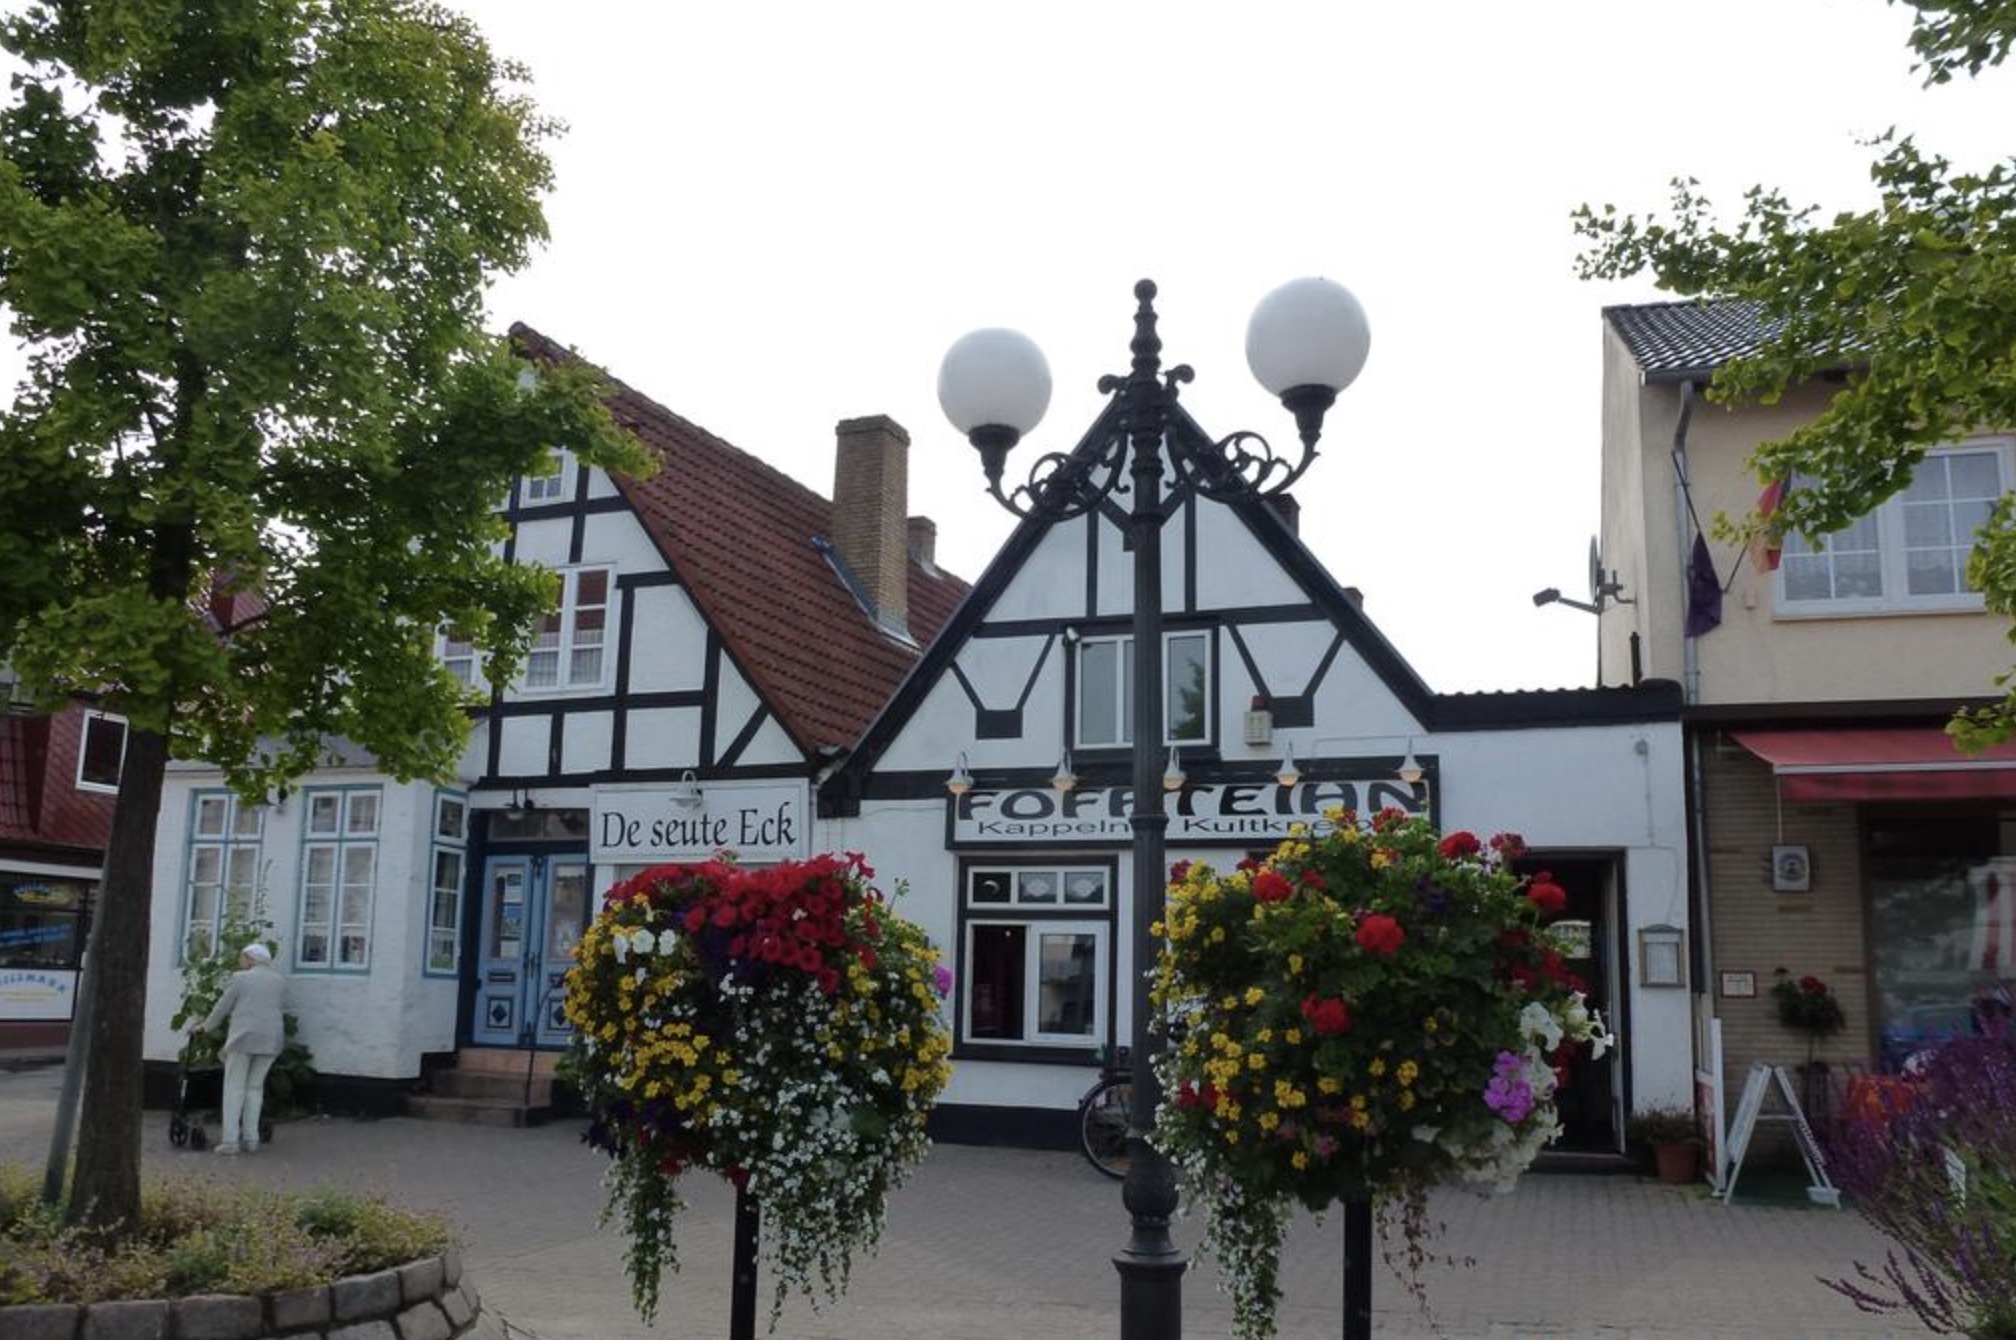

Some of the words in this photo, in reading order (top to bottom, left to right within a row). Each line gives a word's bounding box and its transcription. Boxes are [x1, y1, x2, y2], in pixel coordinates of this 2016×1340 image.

[600, 811, 641, 847] De
[650, 813, 728, 847] seute
[738, 801, 796, 846] Eck
